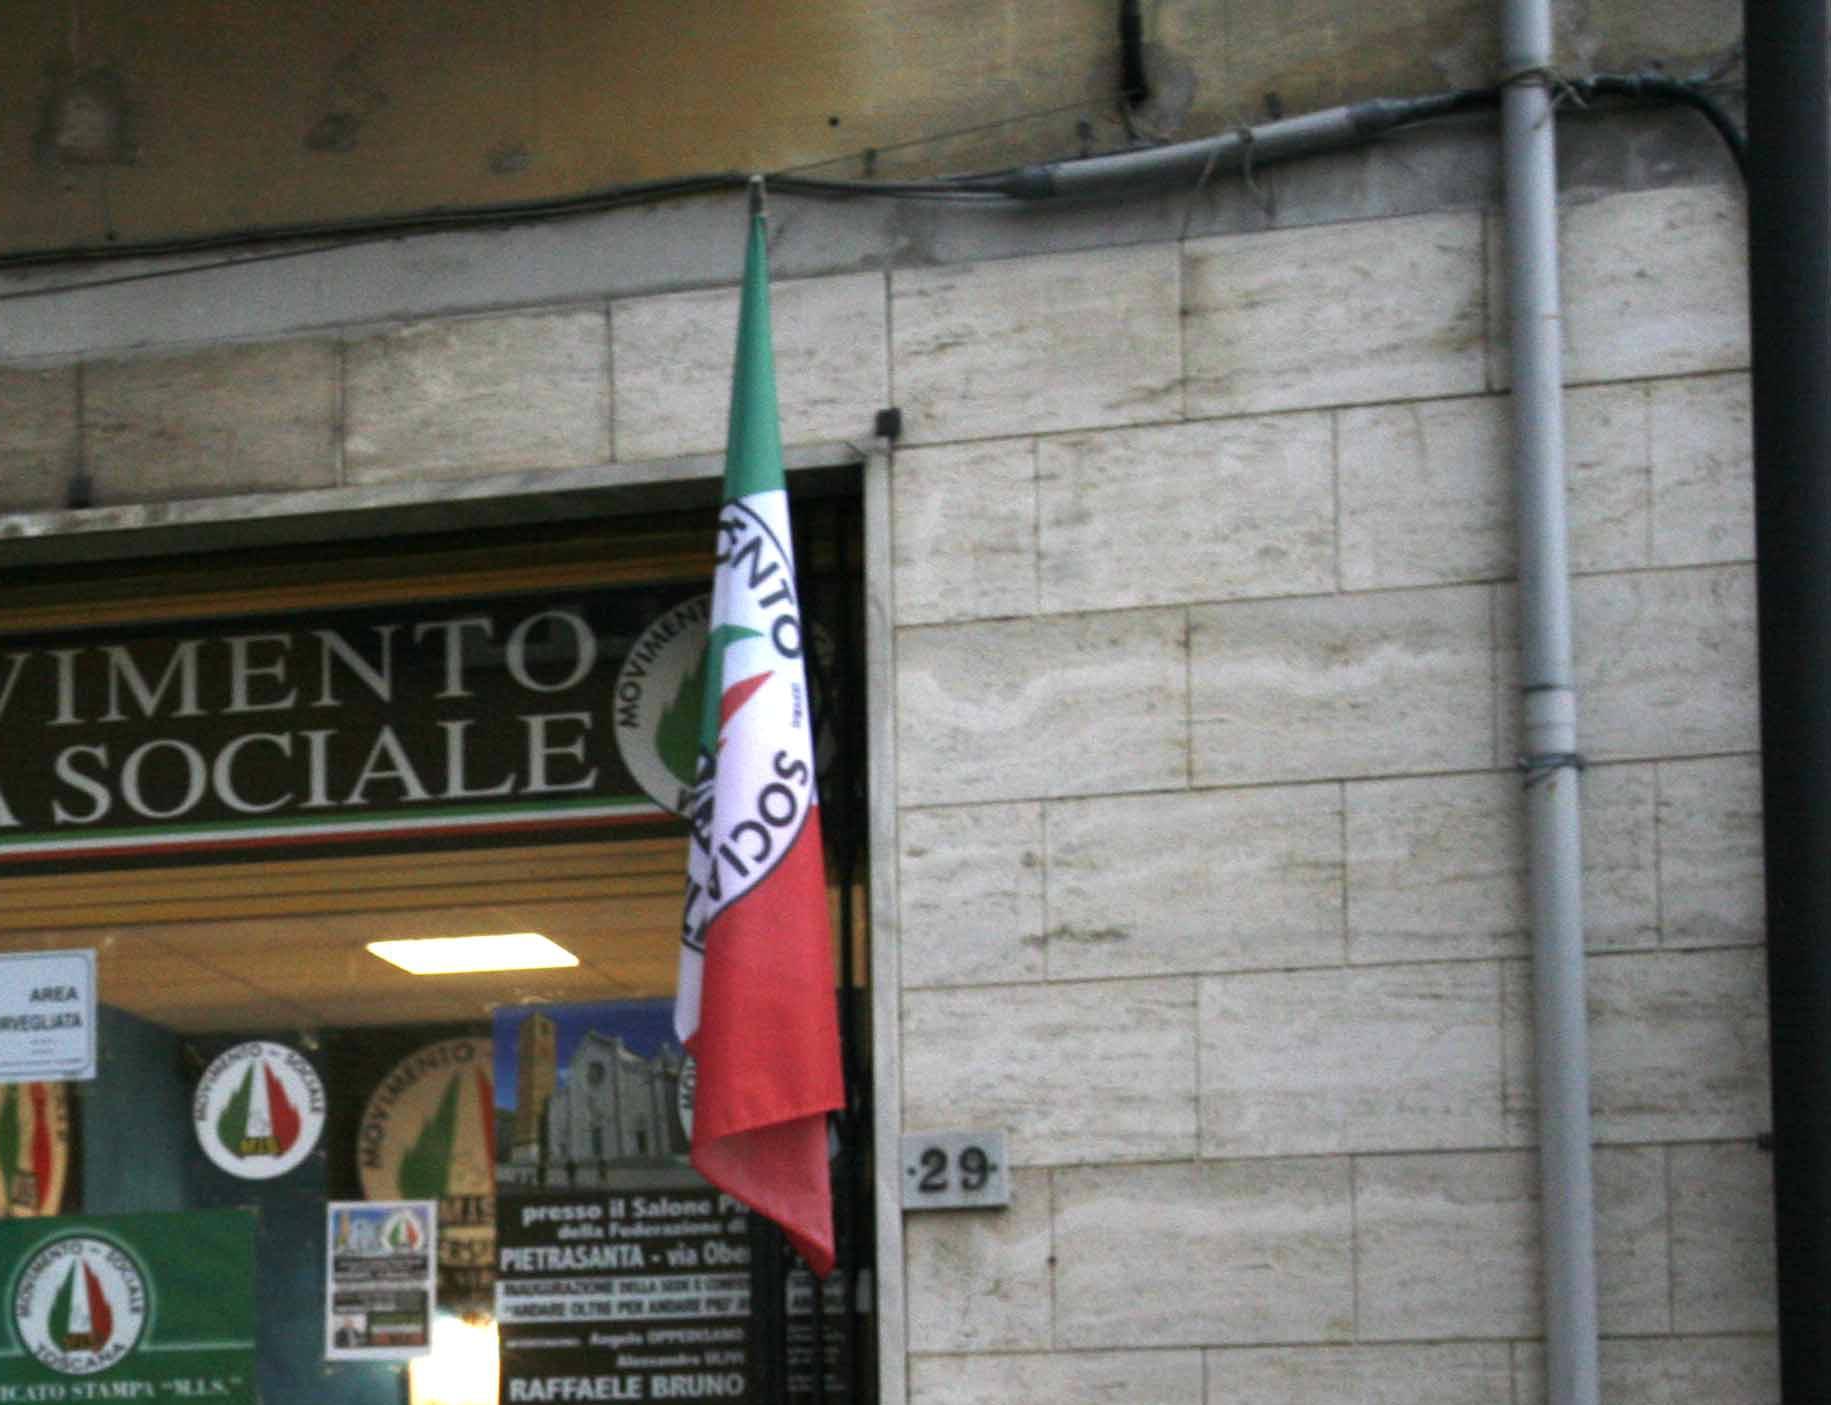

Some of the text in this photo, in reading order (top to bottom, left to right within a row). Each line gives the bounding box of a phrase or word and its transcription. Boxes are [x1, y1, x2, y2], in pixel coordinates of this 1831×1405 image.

[51, 711, 598, 825] SOCIALE
[29, 985, 79, 1004] AREA
[919, 1146, 989, 1194] 29
[521, 1204, 603, 1227] presso
[631, 1197, 713, 1218] Salone
[500, 1244, 645, 1272] PIETRASANTA
[668, 1243, 698, 1267] via
[71, 1379, 156, 1400] STAMPA
[509, 1373, 745, 1402] RAFFAELE BRUNO
